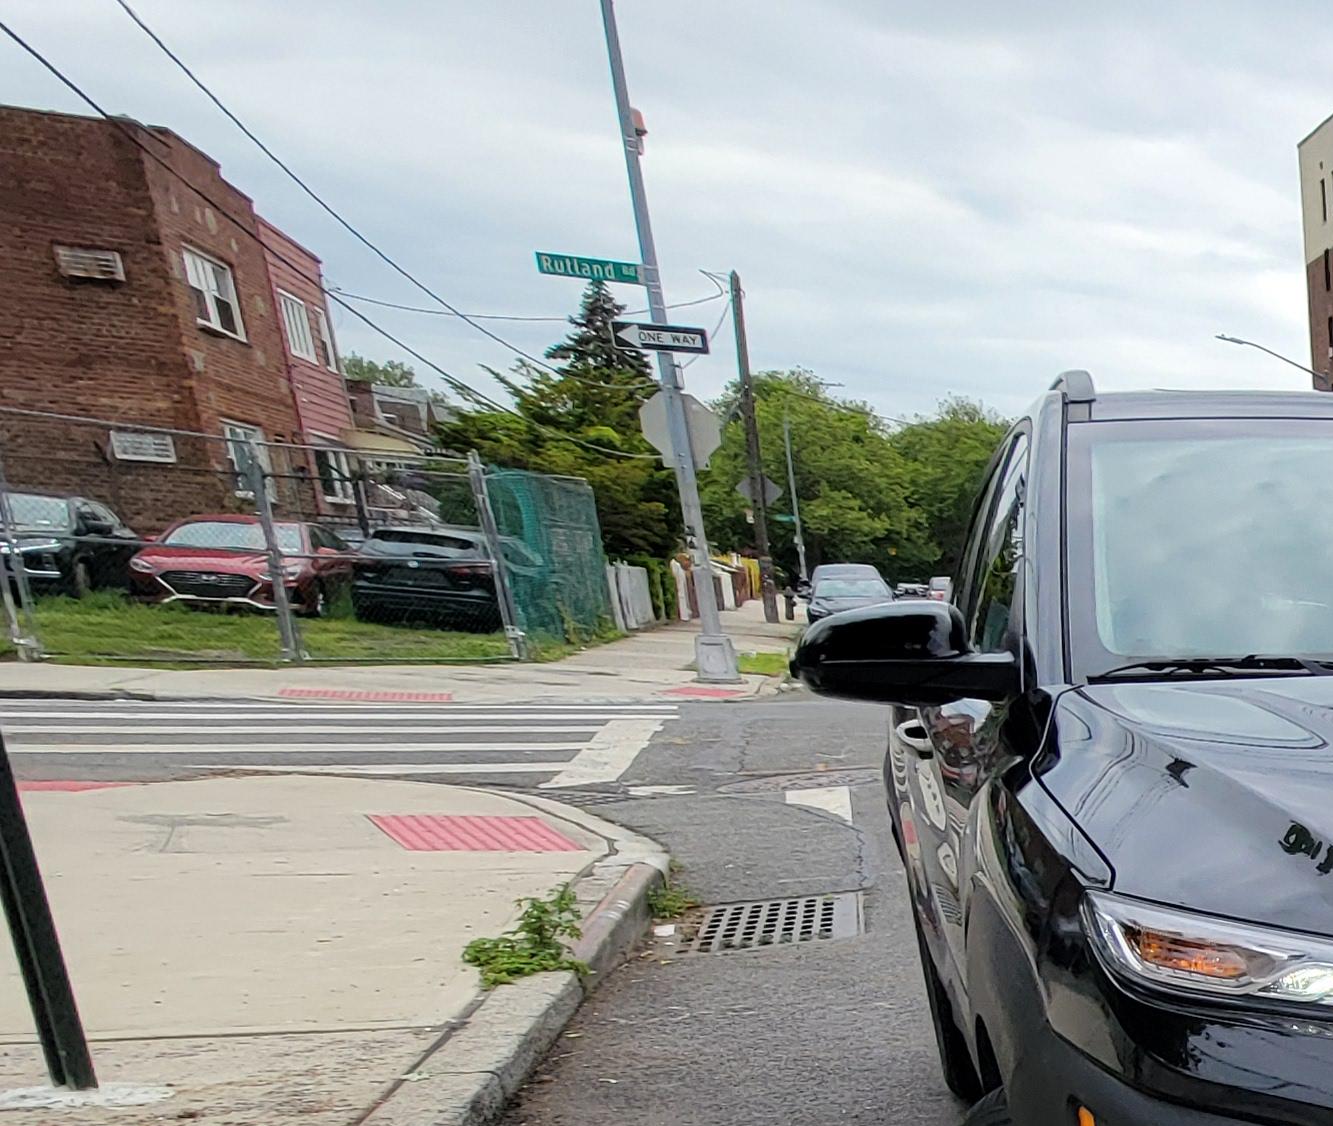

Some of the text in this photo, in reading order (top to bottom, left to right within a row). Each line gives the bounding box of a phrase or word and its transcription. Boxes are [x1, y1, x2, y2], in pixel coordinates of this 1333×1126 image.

[540, 255, 616, 279] Rutland
[639, 331, 698, 346] ONE WAY
